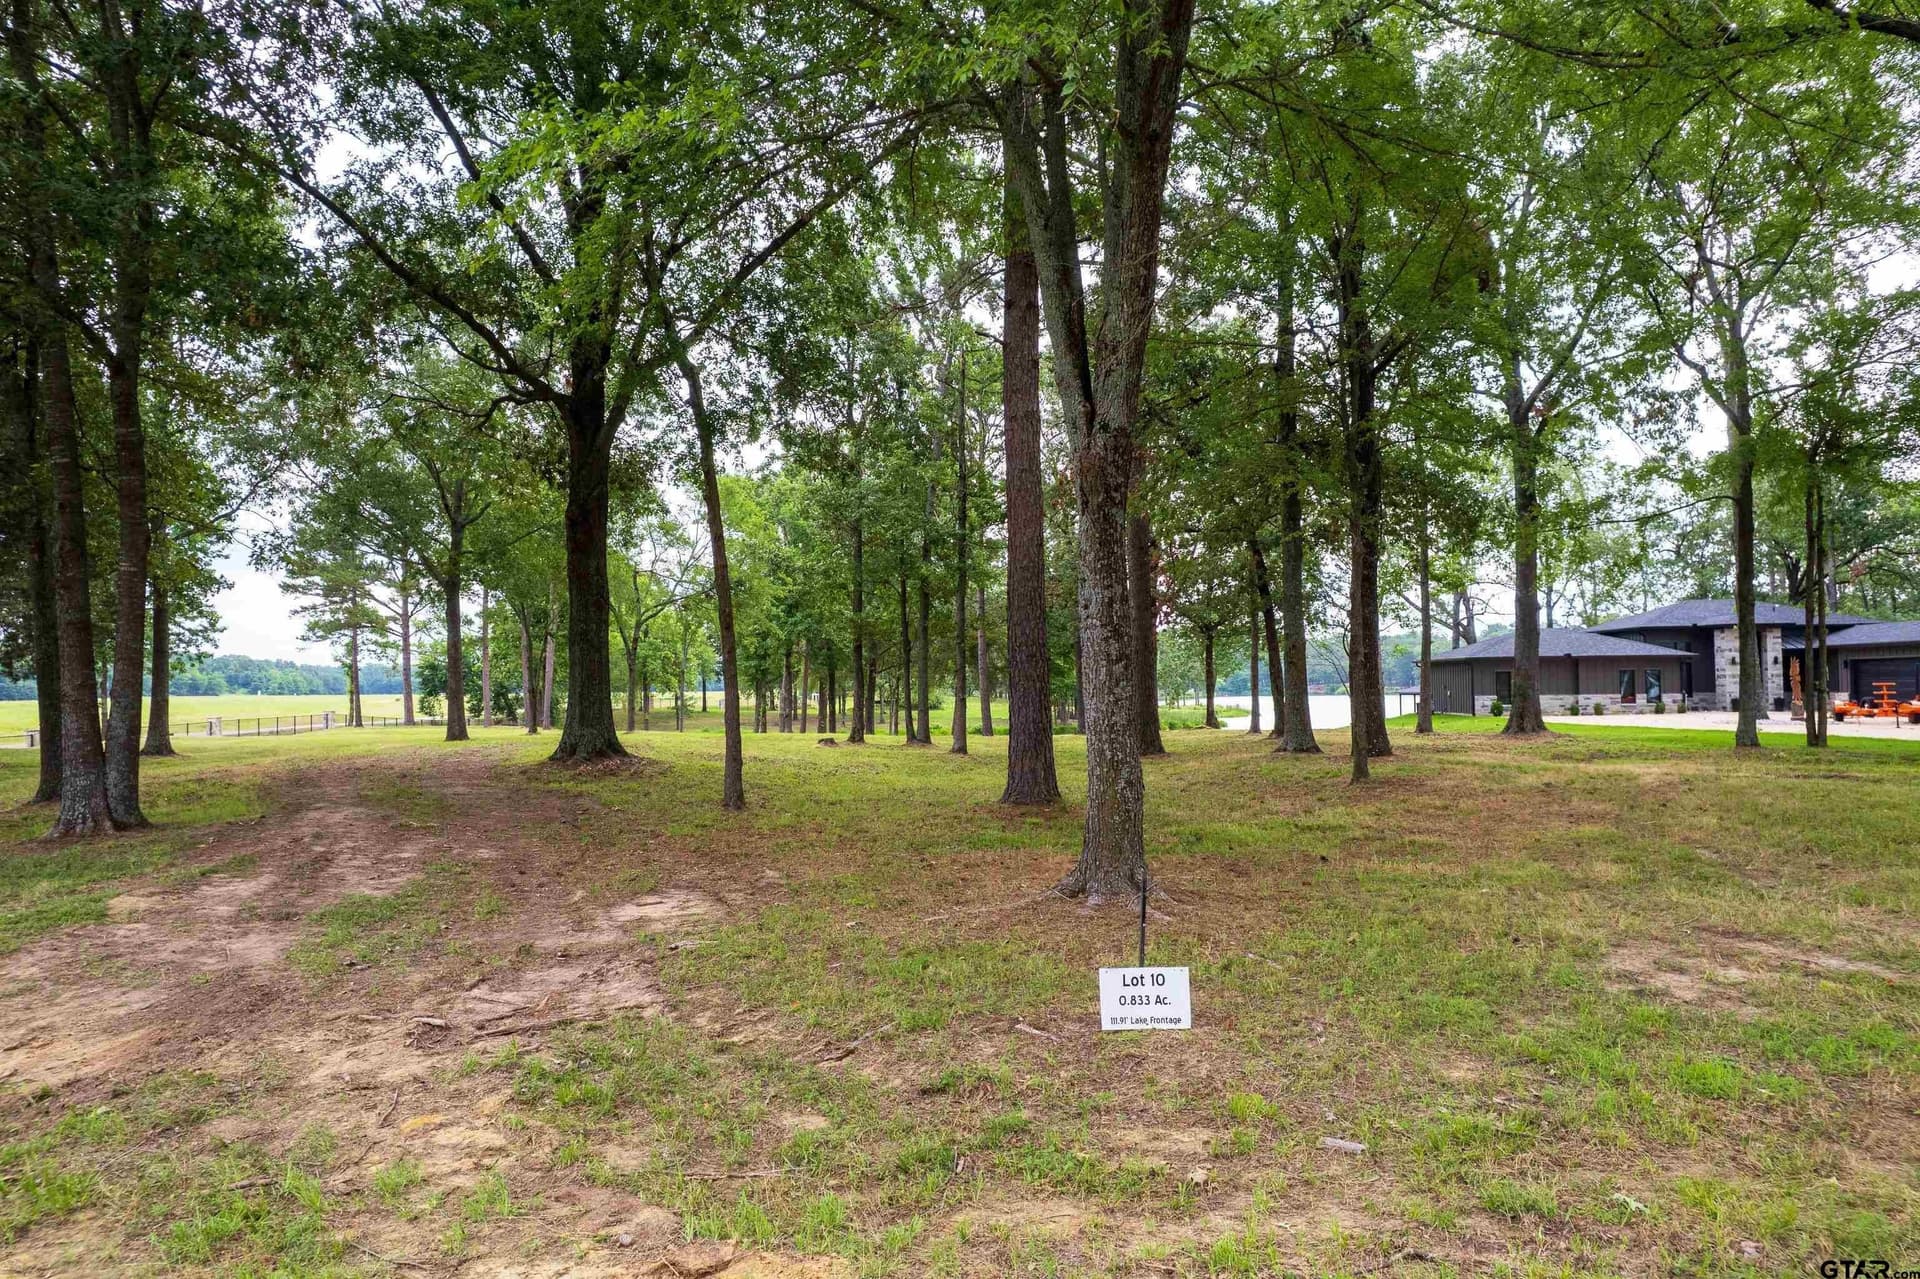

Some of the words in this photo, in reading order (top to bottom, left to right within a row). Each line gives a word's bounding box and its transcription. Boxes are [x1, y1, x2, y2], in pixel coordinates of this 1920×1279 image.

[1122, 973, 1145, 987] Lot
[1150, 973, 1166, 987] 10
[1118, 995, 1151, 1006] 0.833
[1154, 994, 1171, 1006] Ac.
[1130, 1016, 1148, 1025] Lake
[1149, 1016, 1182, 1025] Frontage
